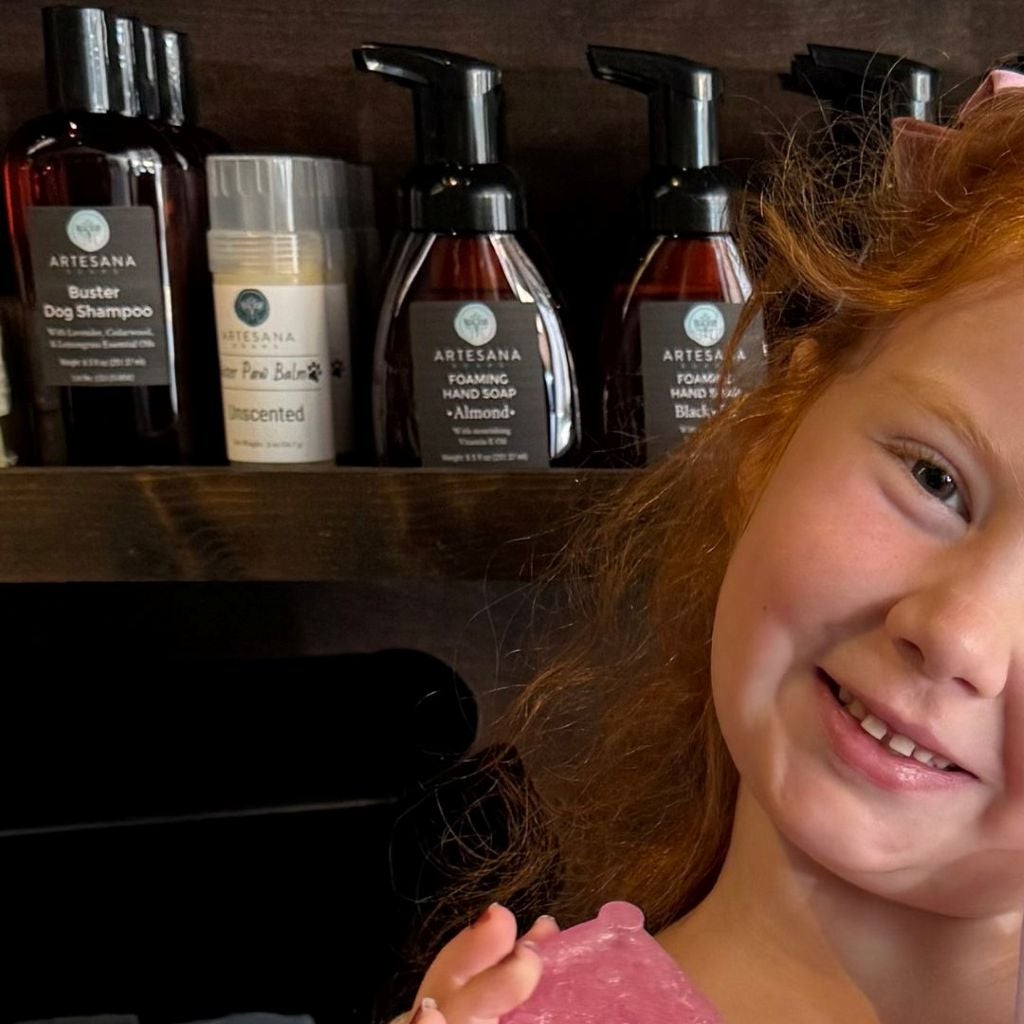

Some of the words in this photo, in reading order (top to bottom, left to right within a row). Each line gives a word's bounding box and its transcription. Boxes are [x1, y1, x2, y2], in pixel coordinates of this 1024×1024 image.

[49, 255, 137, 268] ARTESANA
[67, 285, 121, 299] Buster
[43, 303, 75, 322] Dog
[76, 304, 154, 321] Shampoo
[433, 349, 522, 362] ARTESANA
[663, 349, 747, 362] ARTESAA
[242, 360, 269, 380] Paw
[273, 361, 307, 381] Balm
[448, 374, 509, 385] FOAMING
[442, 388, 480, 399] HAND
[481, 388, 517, 399] SOAP
[670, 388, 707, 399] HAND
